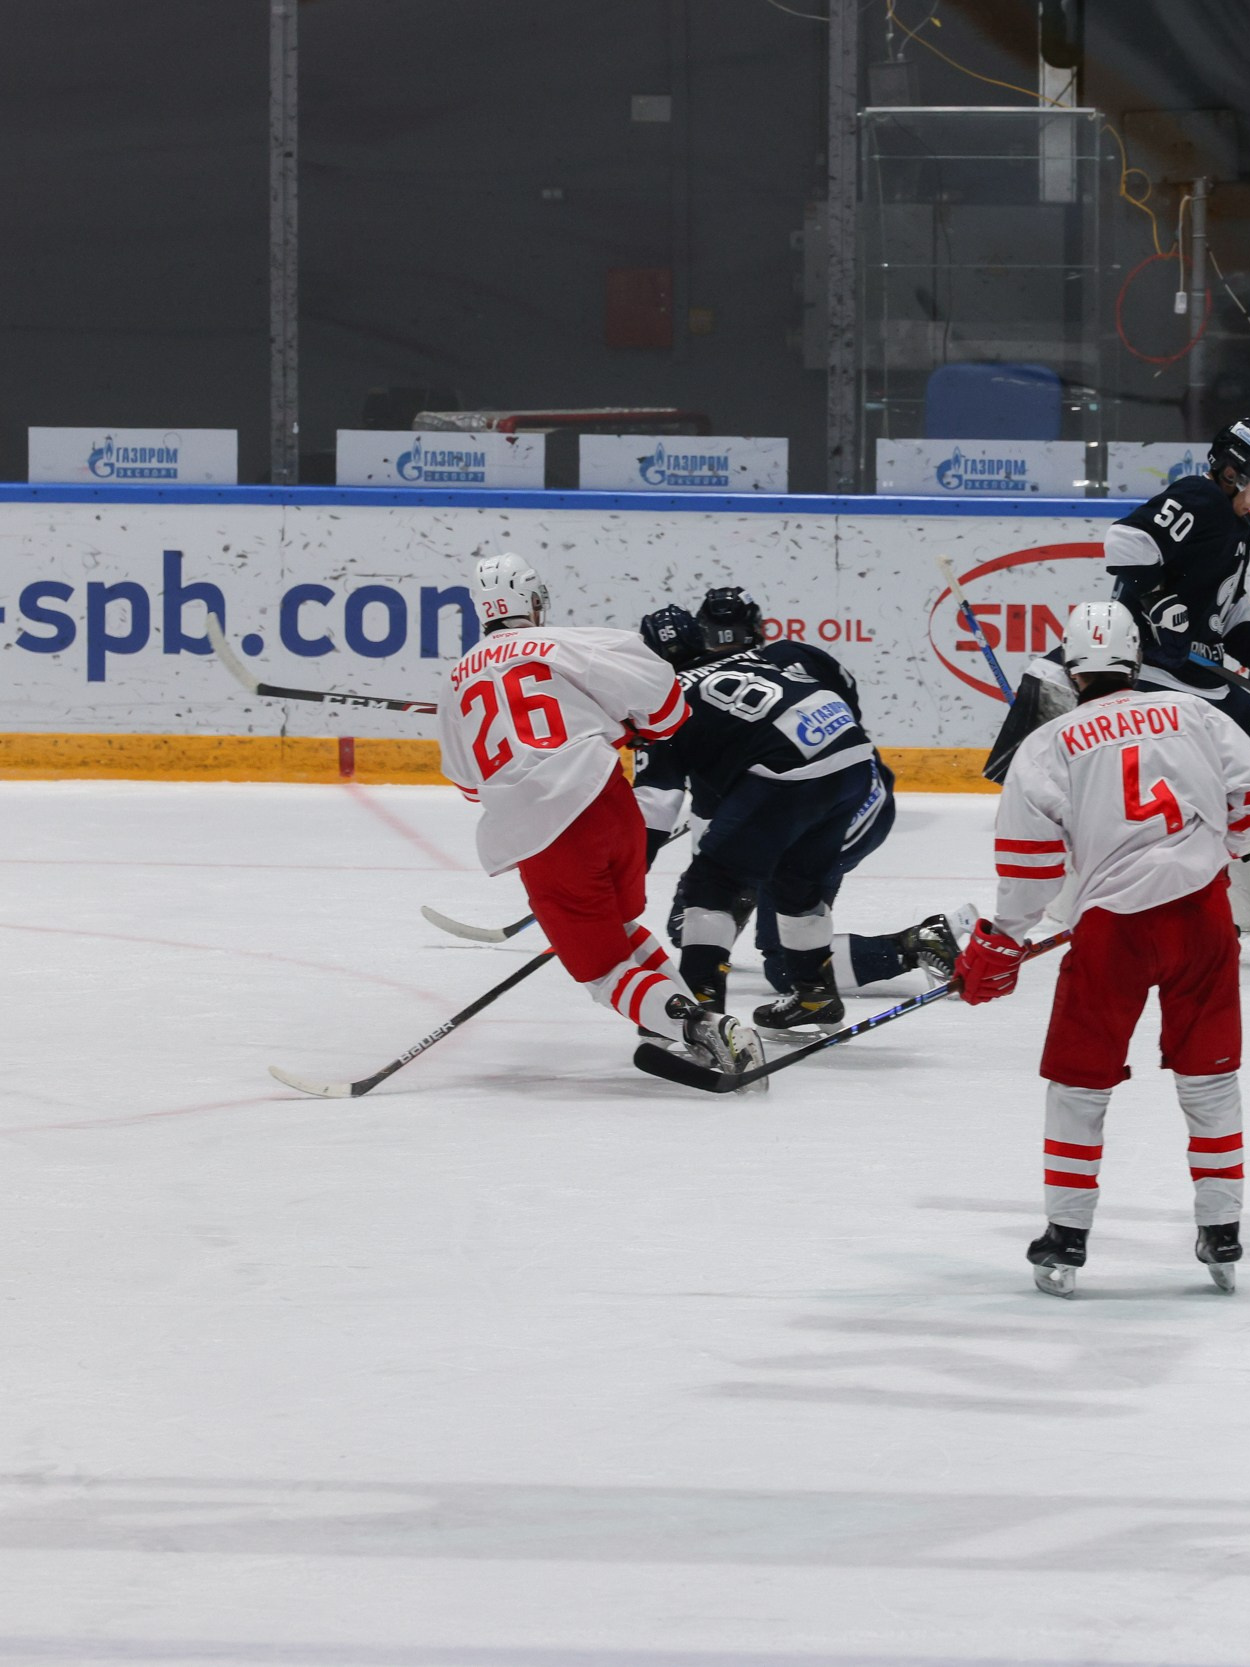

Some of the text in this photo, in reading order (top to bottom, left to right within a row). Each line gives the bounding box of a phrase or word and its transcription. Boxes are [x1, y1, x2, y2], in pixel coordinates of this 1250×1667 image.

[116, 447, 178, 464] ГАЗПРОМ
[424, 451, 486, 468] ГАЗПРОМ
[667, 455, 729, 472] ГАЗПРОМ
[964, 459, 1026, 475] ГАЗПРОМ
[1153, 498, 1195, 543] 50
[482, 599, 509, 618] 26
[657, 625, 677, 642] 85
[718, 629, 733, 643] 18
[818, 619, 873, 643] OIL
[956, 603, 1078, 653] SIN
[1092, 625, 1103, 645] 4
[451, 640, 556, 692] SHUMILOV
[460, 660, 569, 781] 26
[1061, 705, 1180, 756] KHRAPOV
[1121, 744, 1185, 835] 4
[399, 1020, 455, 1064] BAUER
